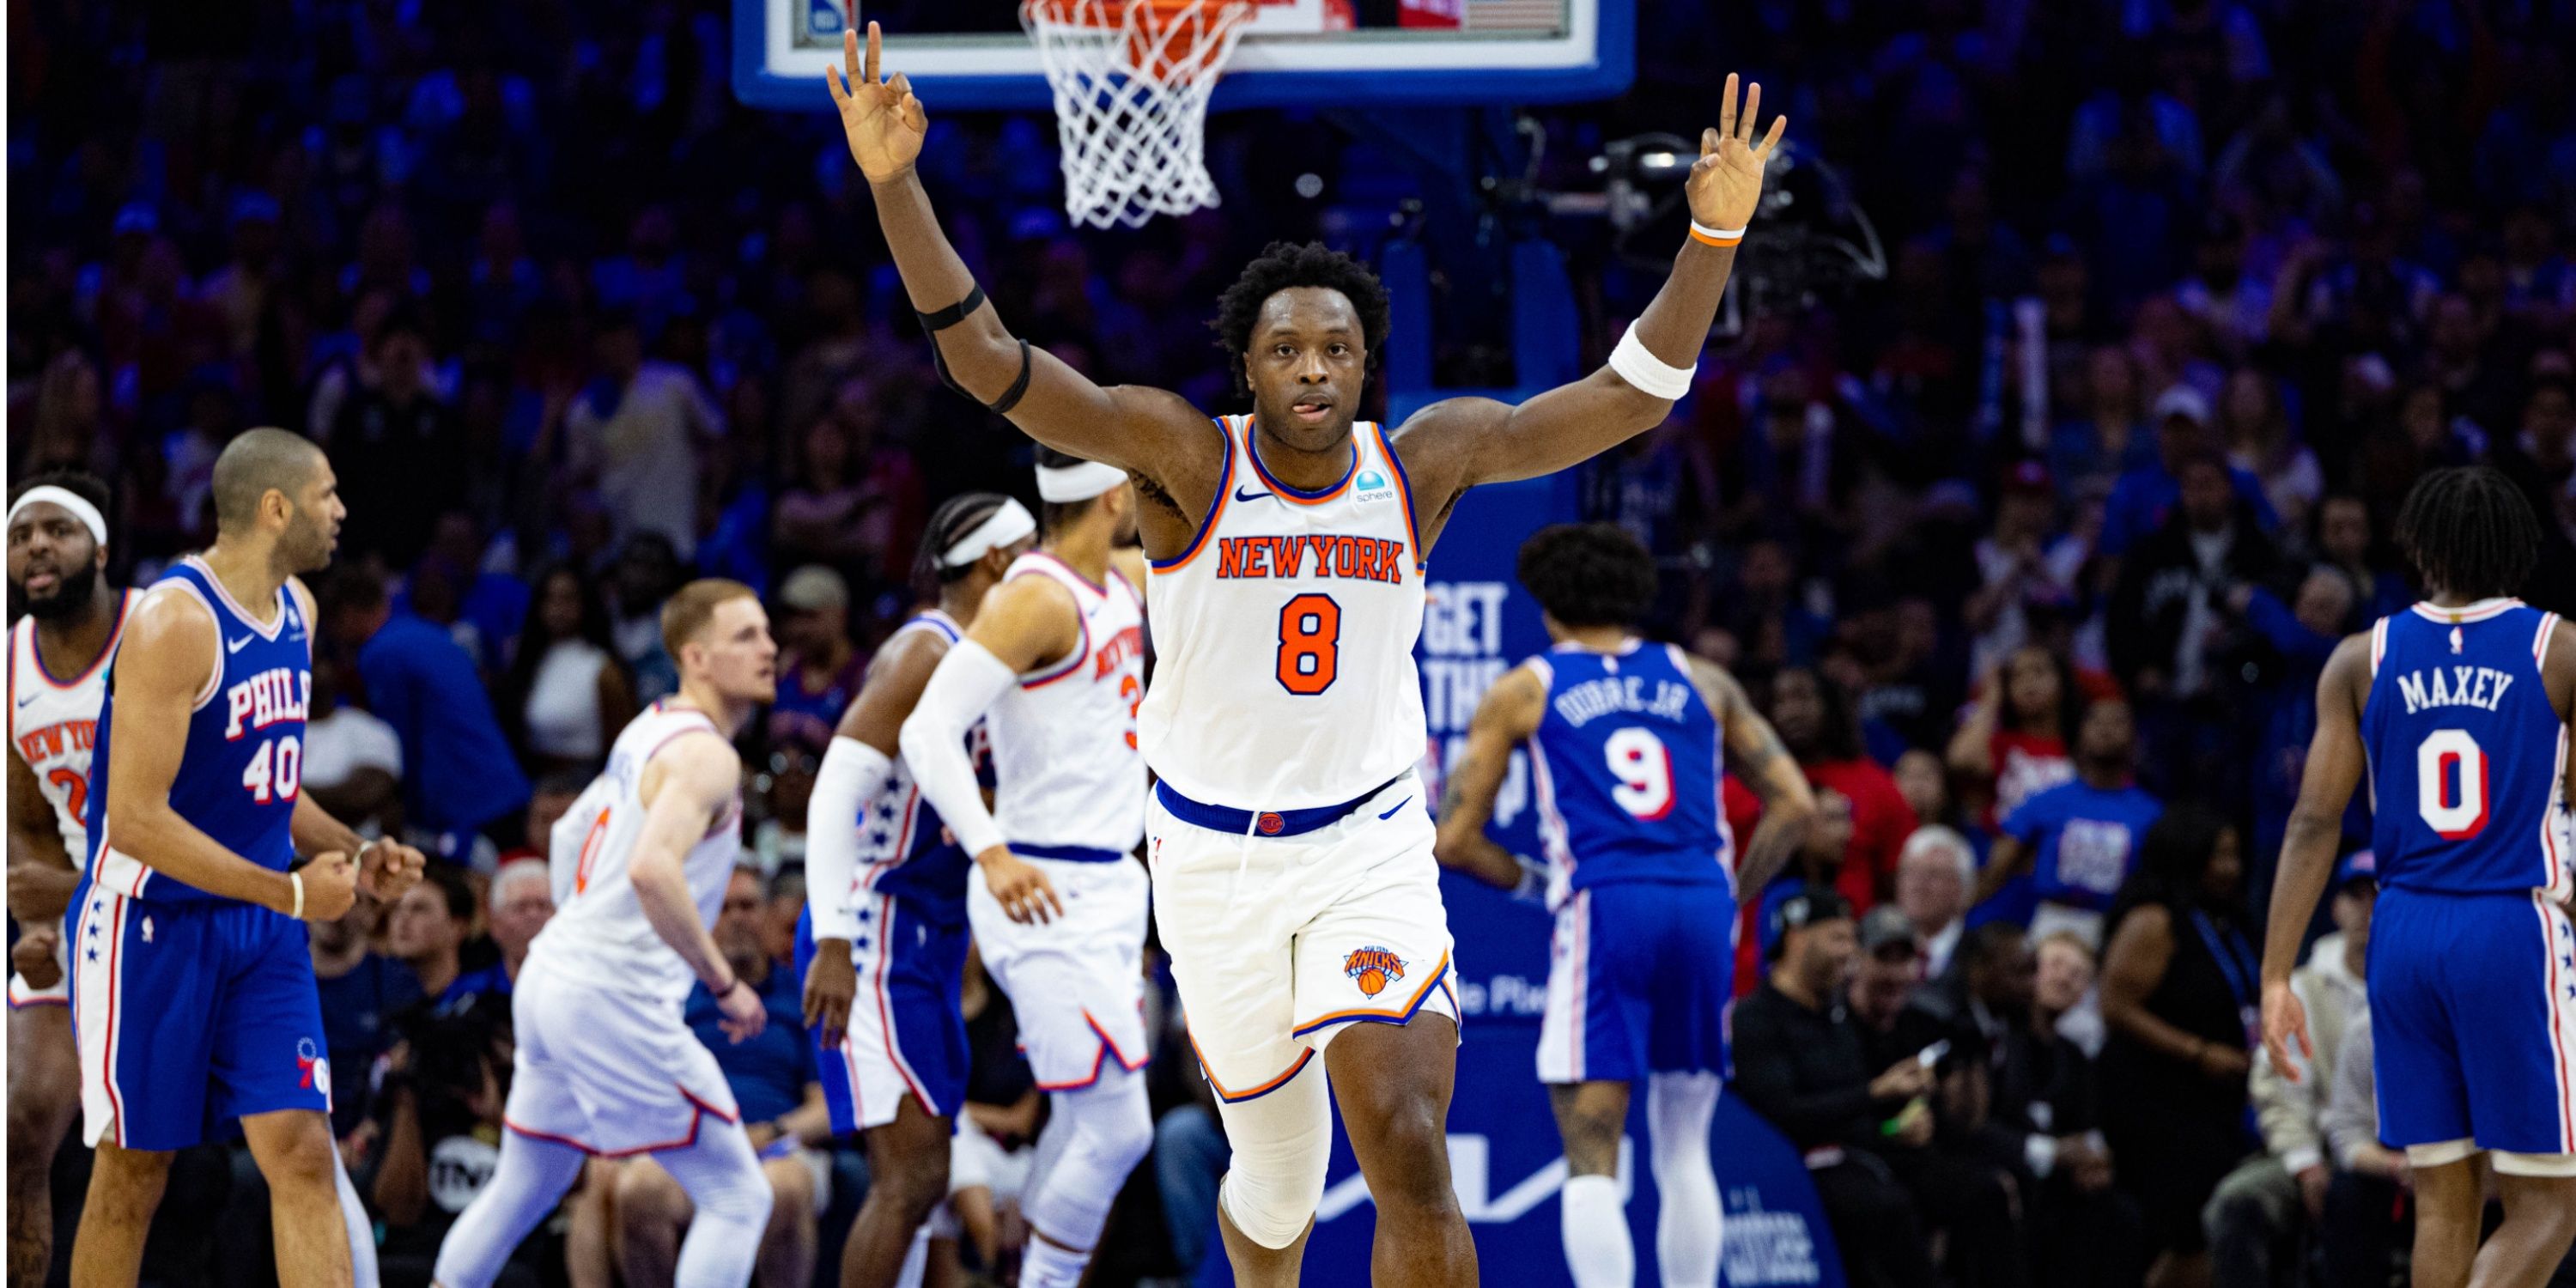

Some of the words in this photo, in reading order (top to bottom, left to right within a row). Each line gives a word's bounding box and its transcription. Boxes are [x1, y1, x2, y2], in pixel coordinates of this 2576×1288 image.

[1357, 489, 1393, 502] sphere
[1217, 535, 1307, 579] NEW
[1307, 534, 1404, 586] YORK
[1275, 592, 1341, 696] 8
[1422, 581, 1509, 657] GET
[2397, 665, 2514, 715] MAXEY
[18, 721, 65, 766] NEW
[64, 718, 98, 752] YO
[242, 735, 302, 805] 40
[1604, 726, 1676, 822] 9
[47, 764, 93, 829] 2
[2417, 729, 2490, 841] 0
[576, 805, 612, 895] 0
[1345, 948, 1406, 980] KNICKS
[296, 1055, 329, 1095] 76
